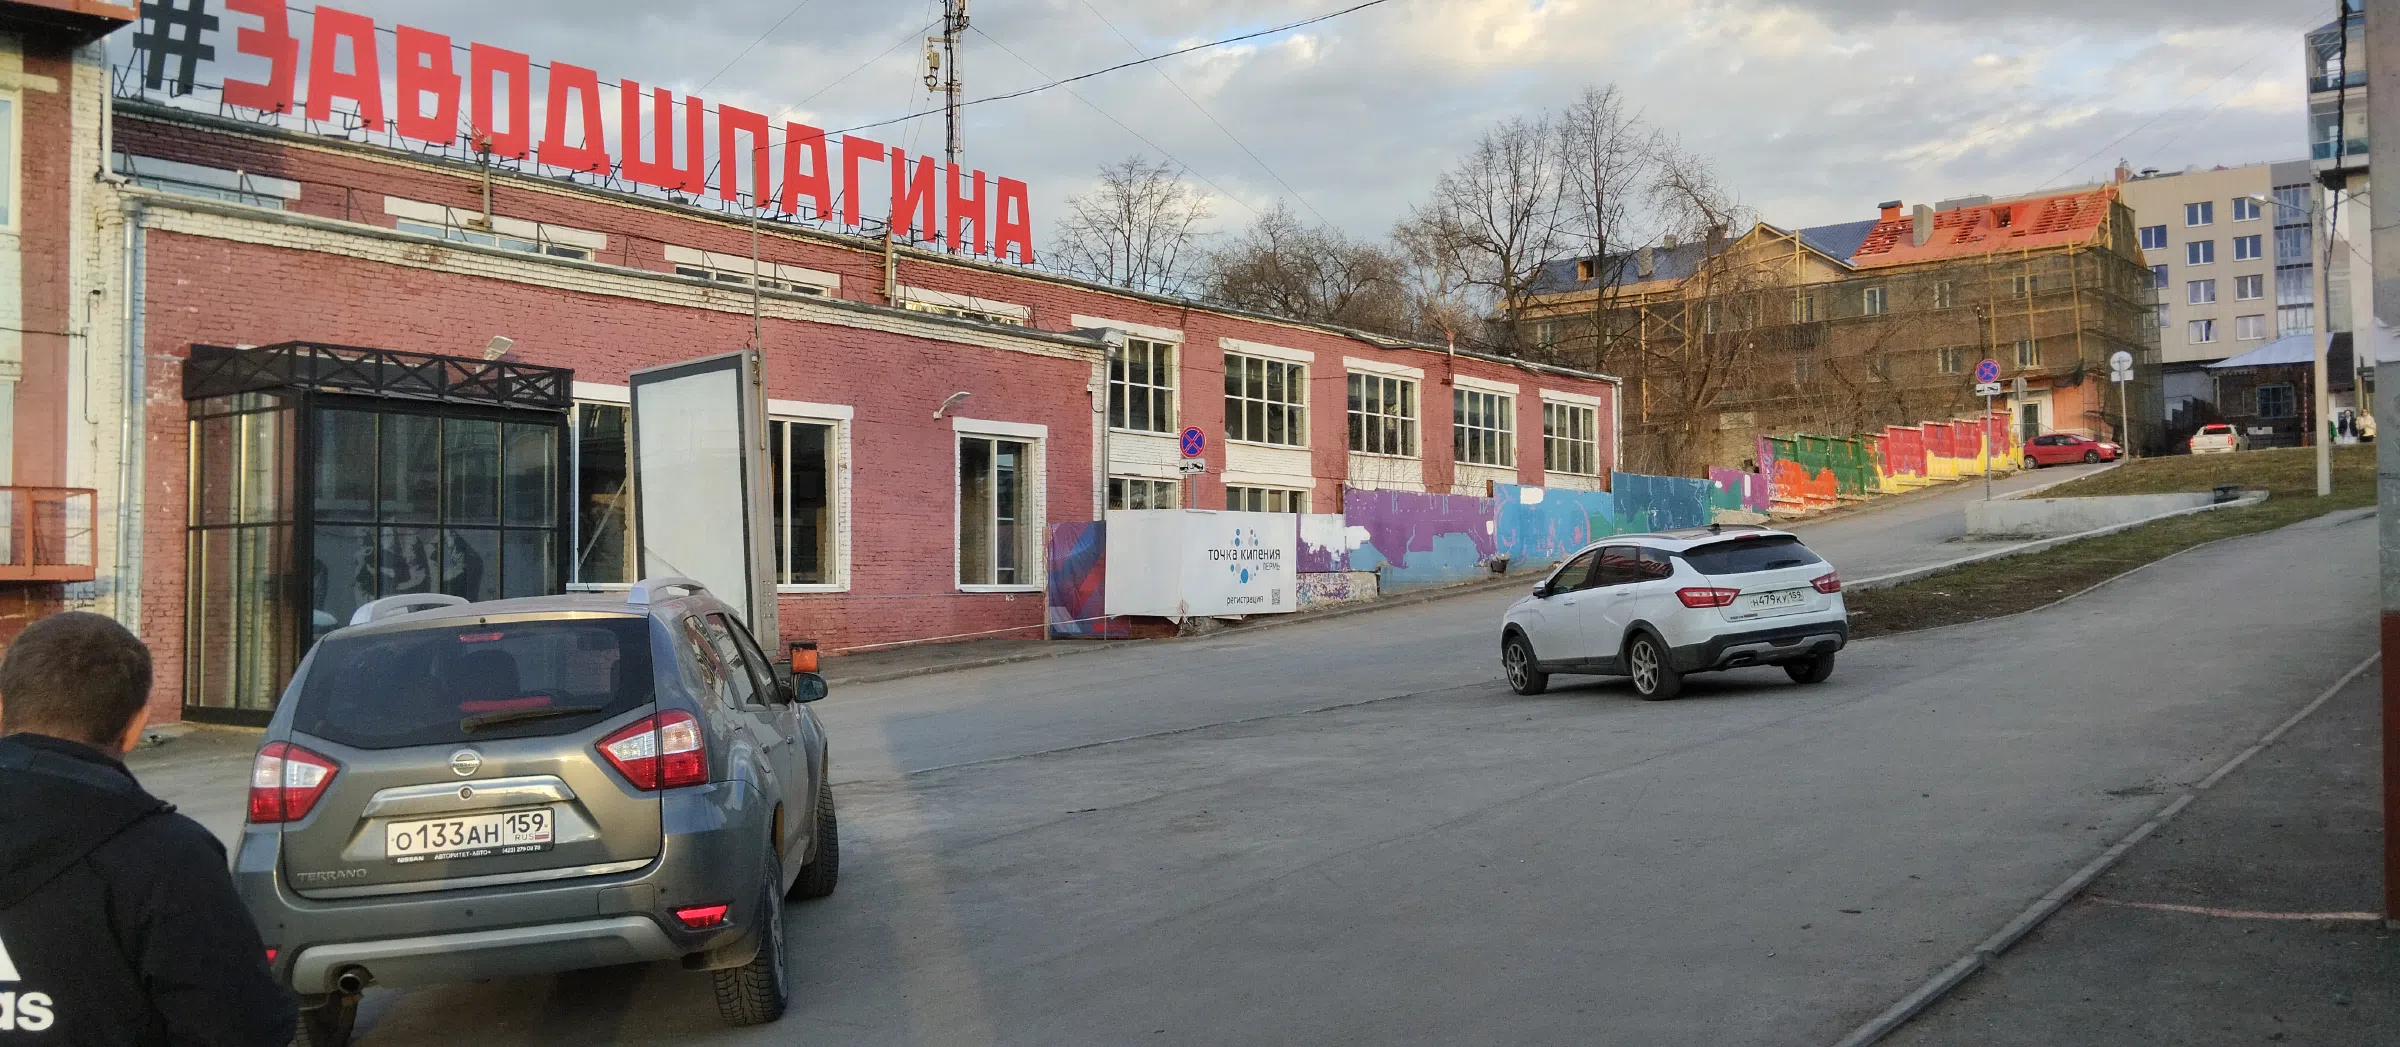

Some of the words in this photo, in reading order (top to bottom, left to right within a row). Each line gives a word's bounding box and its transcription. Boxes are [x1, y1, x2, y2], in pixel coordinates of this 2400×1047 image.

[1208, 549, 1238, 561] точка
[1240, 548, 1281, 561] кипения
[1262, 562, 1281, 571] ПЕРМЬ
[1226, 595, 1264, 606] регистрация
[505, 812, 545, 834] 159
[514, 832, 535, 842] RUS
[397, 855, 425, 863] NISSAN
[296, 867, 368, 883] TERRANO
